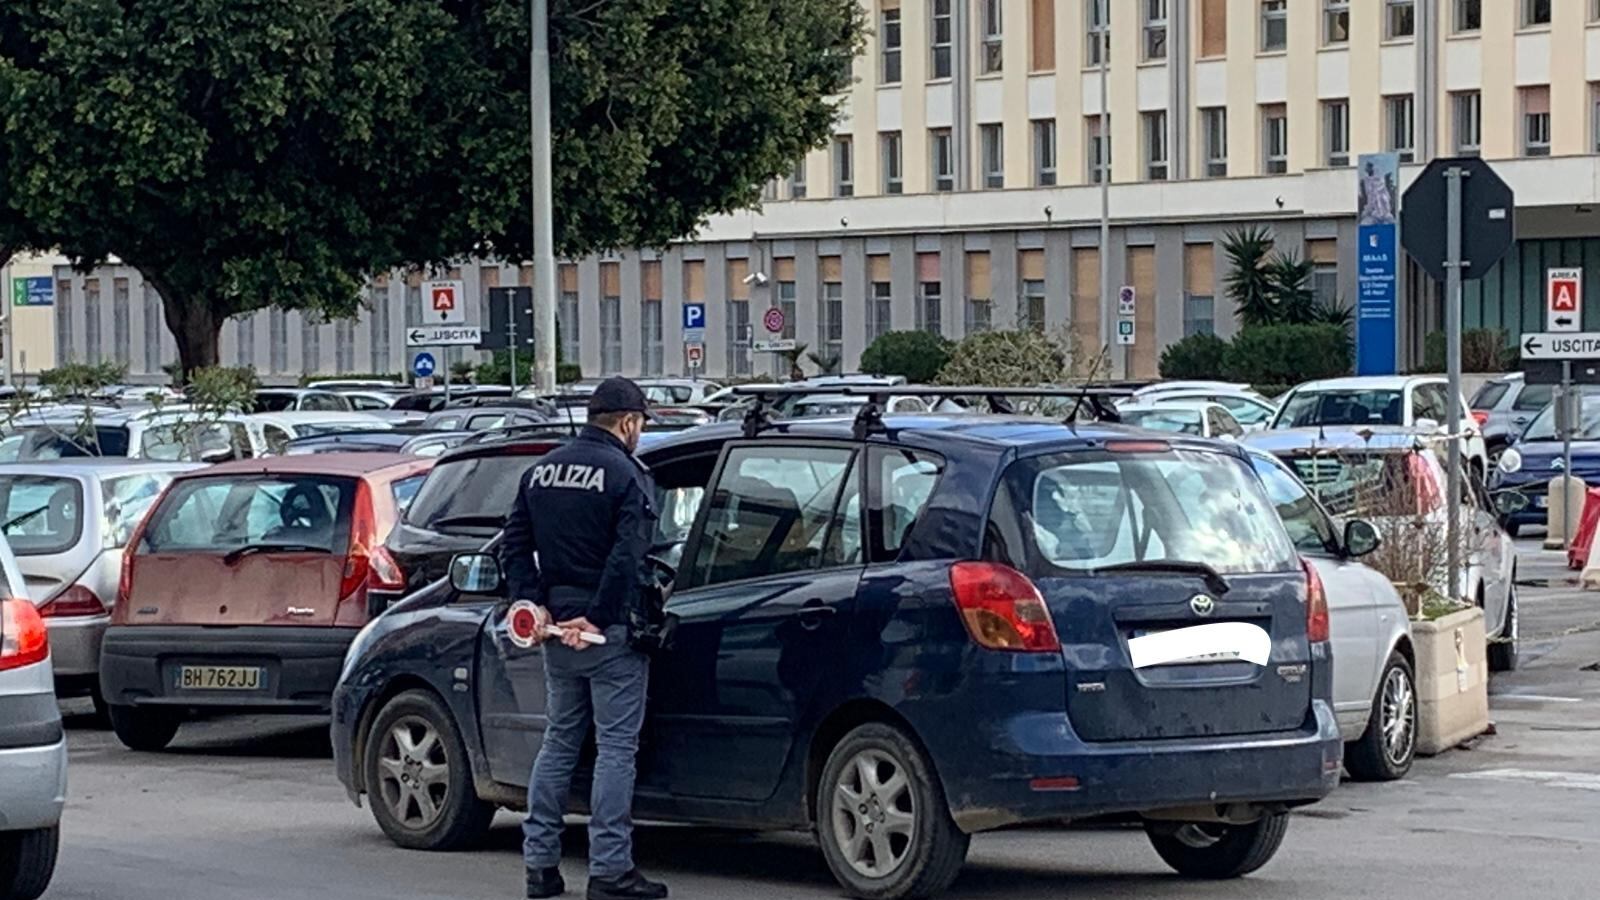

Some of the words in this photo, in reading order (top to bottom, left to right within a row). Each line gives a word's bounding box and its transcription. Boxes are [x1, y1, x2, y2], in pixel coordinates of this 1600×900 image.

[436, 291, 452, 308] A
[1556, 285, 1573, 308] A
[687, 305, 702, 326] P
[528, 463, 605, 493] POLIZIA
[183, 669, 203, 687] BH
[207, 669, 258, 687] 762JJ
